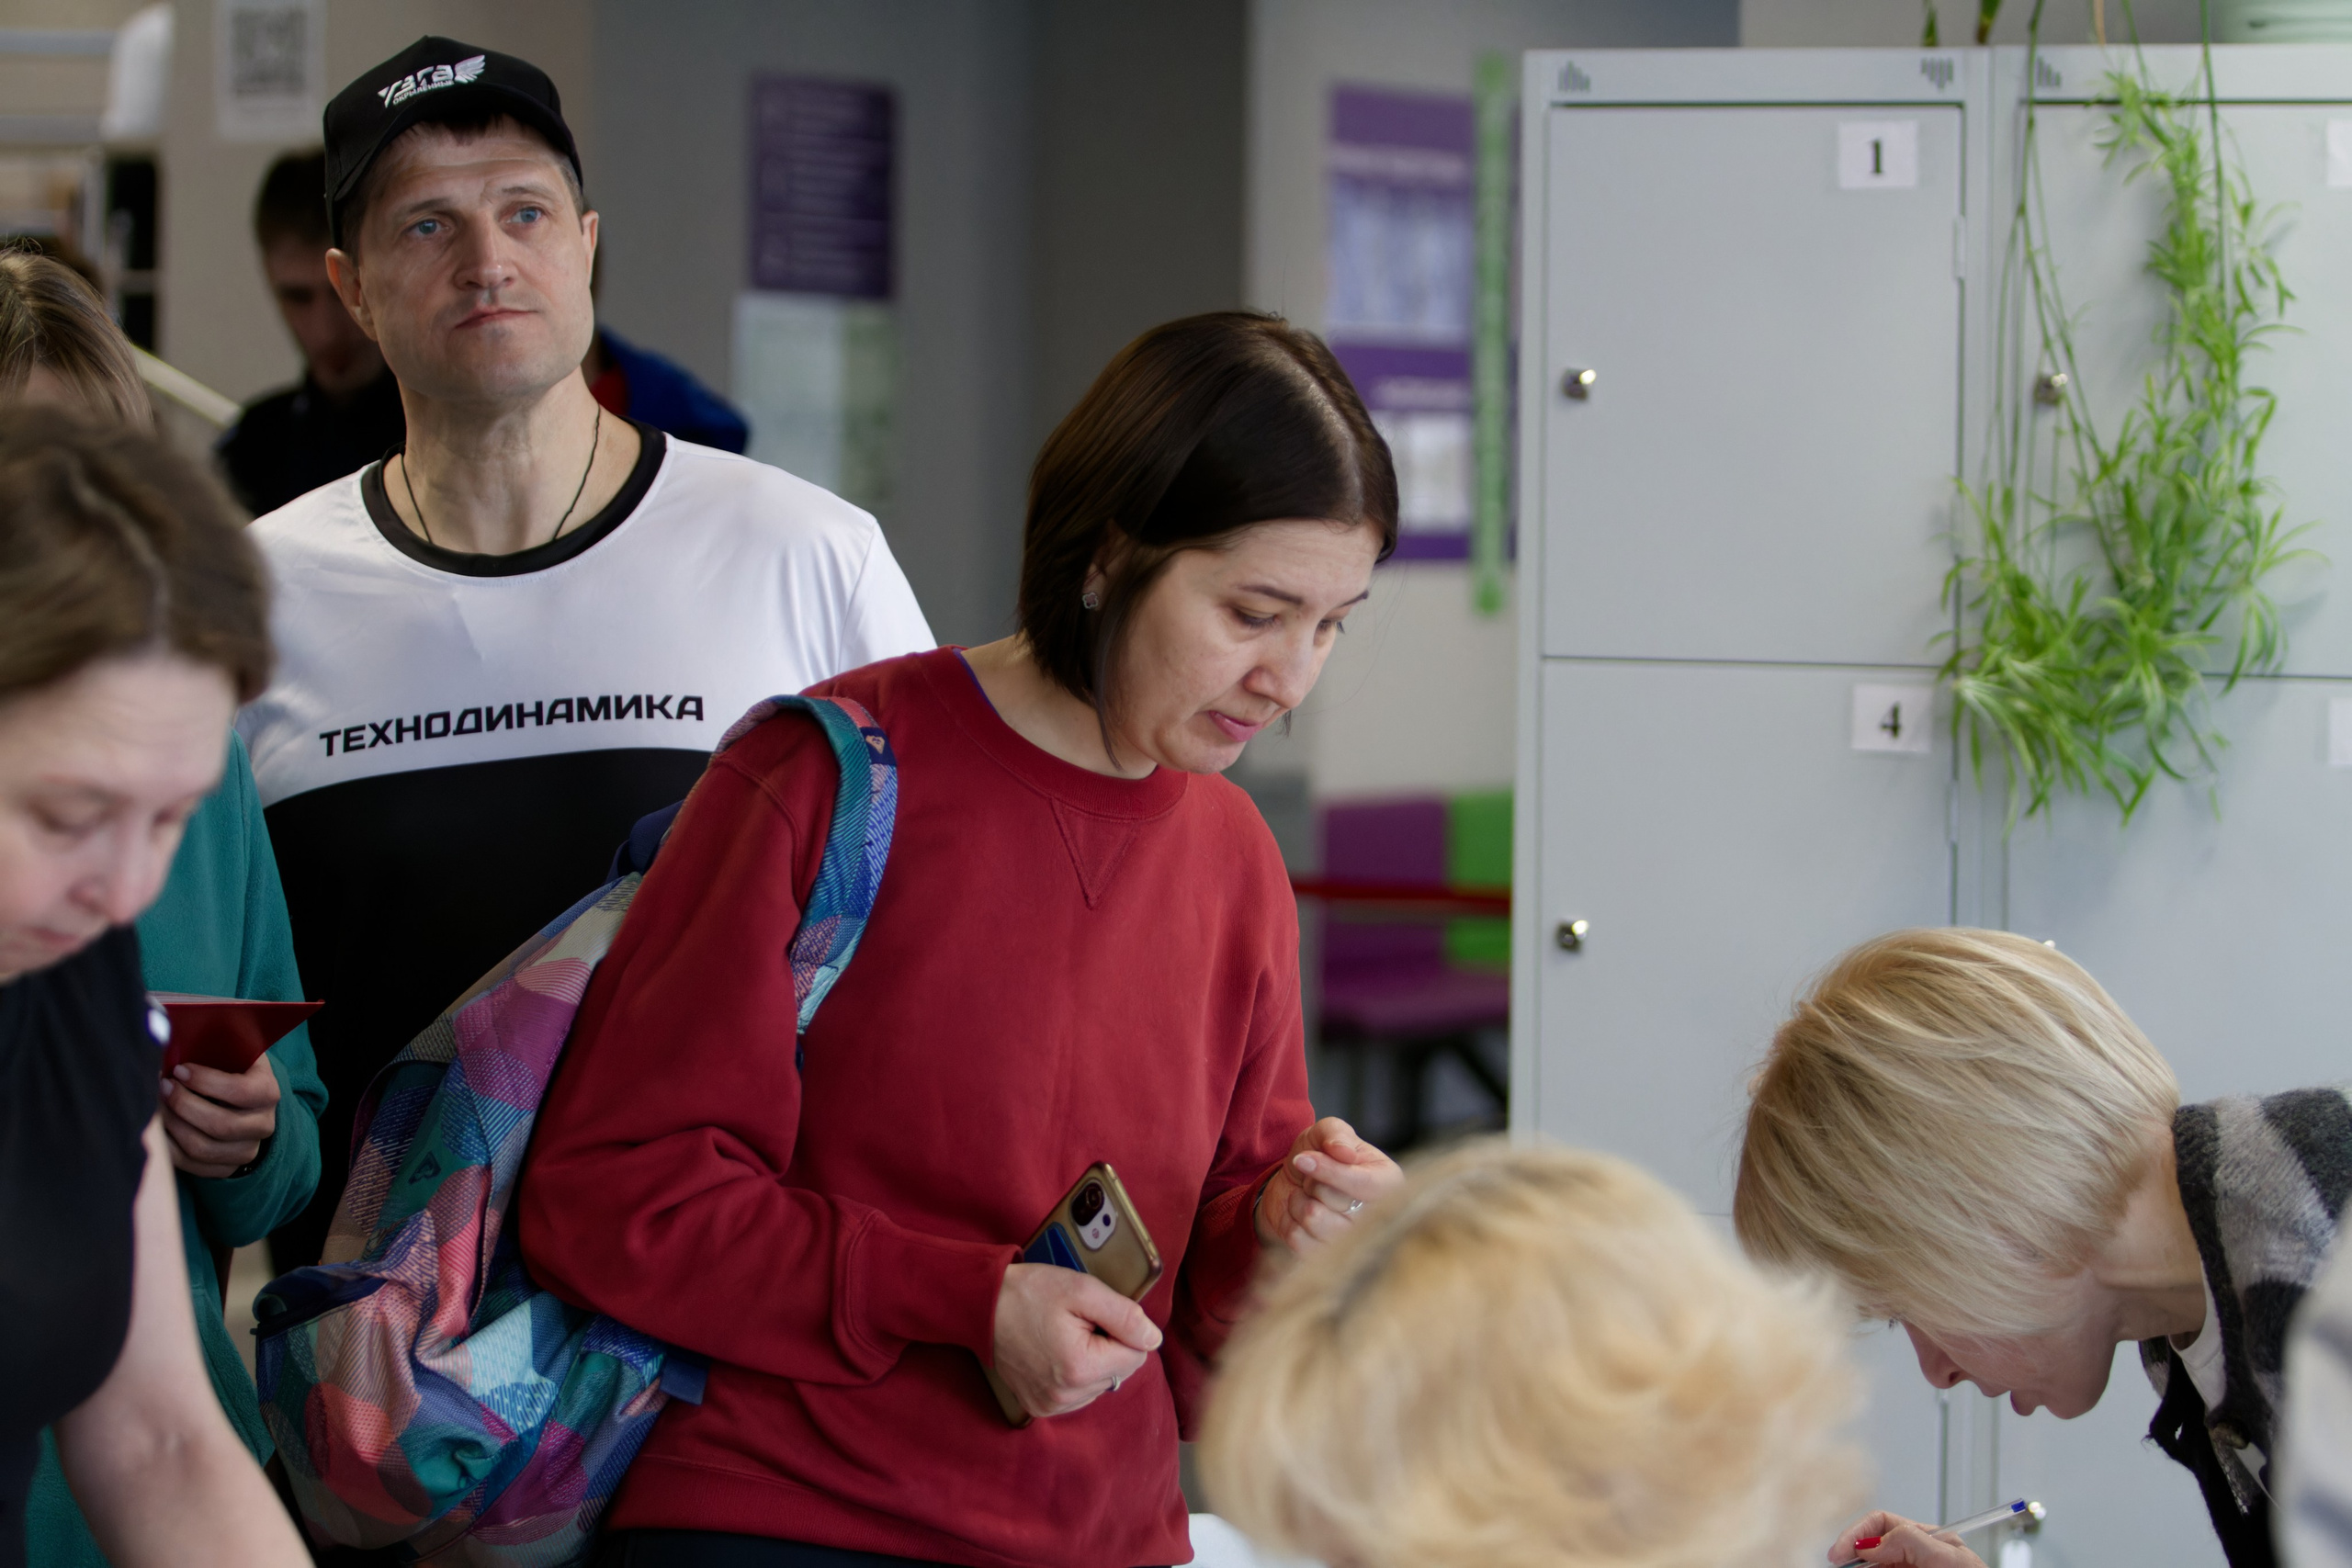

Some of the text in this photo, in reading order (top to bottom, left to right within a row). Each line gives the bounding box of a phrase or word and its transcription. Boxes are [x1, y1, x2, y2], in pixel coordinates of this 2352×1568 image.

[1869, 138, 1884, 175] 1
[319, 694, 704, 757] ТЕХНОДИНАМИКА
[1879, 702, 1902, 739] 4
